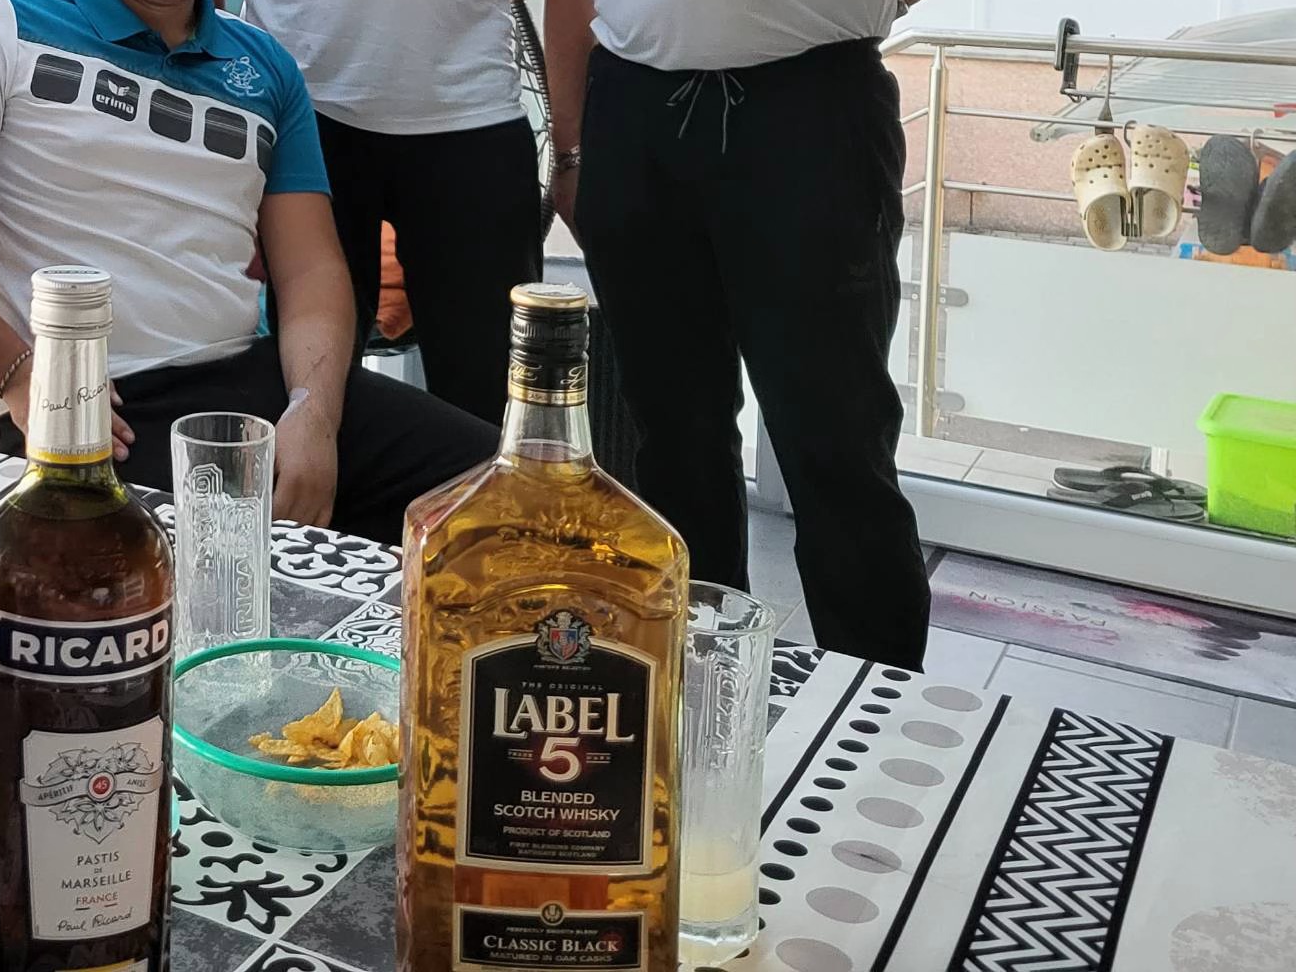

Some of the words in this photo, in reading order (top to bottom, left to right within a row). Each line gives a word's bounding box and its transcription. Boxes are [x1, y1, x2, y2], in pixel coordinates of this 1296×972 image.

[95, 93, 135, 115] erima
[41, 396, 73, 412] Paul
[969, 590, 1107, 627] PASSION
[11, 618, 169, 669] RICARD
[521, 681, 543, 689] THE
[549, 683, 604, 691] ORIGINAL
[492, 687, 635, 744] LABEL
[539, 736, 582, 783] 5
[95, 778, 109, 792] 45
[521, 790, 595, 804] BLENDED
[494, 804, 555, 819] SCOTCH
[559, 808, 620, 821] WHISKY
[503, 826, 545, 836] PRODUCT
[548, 829, 561, 837] OF
[563, 830, 611, 838] SCOTLAND
[77, 851, 120, 866] PASTIS
[61, 870, 132, 889] MARSEILLE
[75, 891, 119, 905] FRANCE
[57, 919, 87, 932] Paul
[92, 906, 133, 928] Ricard
[483, 935, 557, 952] CLASSIC
[561, 939, 619, 952] BLACK
[489, 951, 540, 961] MATURED
[580, 955, 613, 963] CASKS
